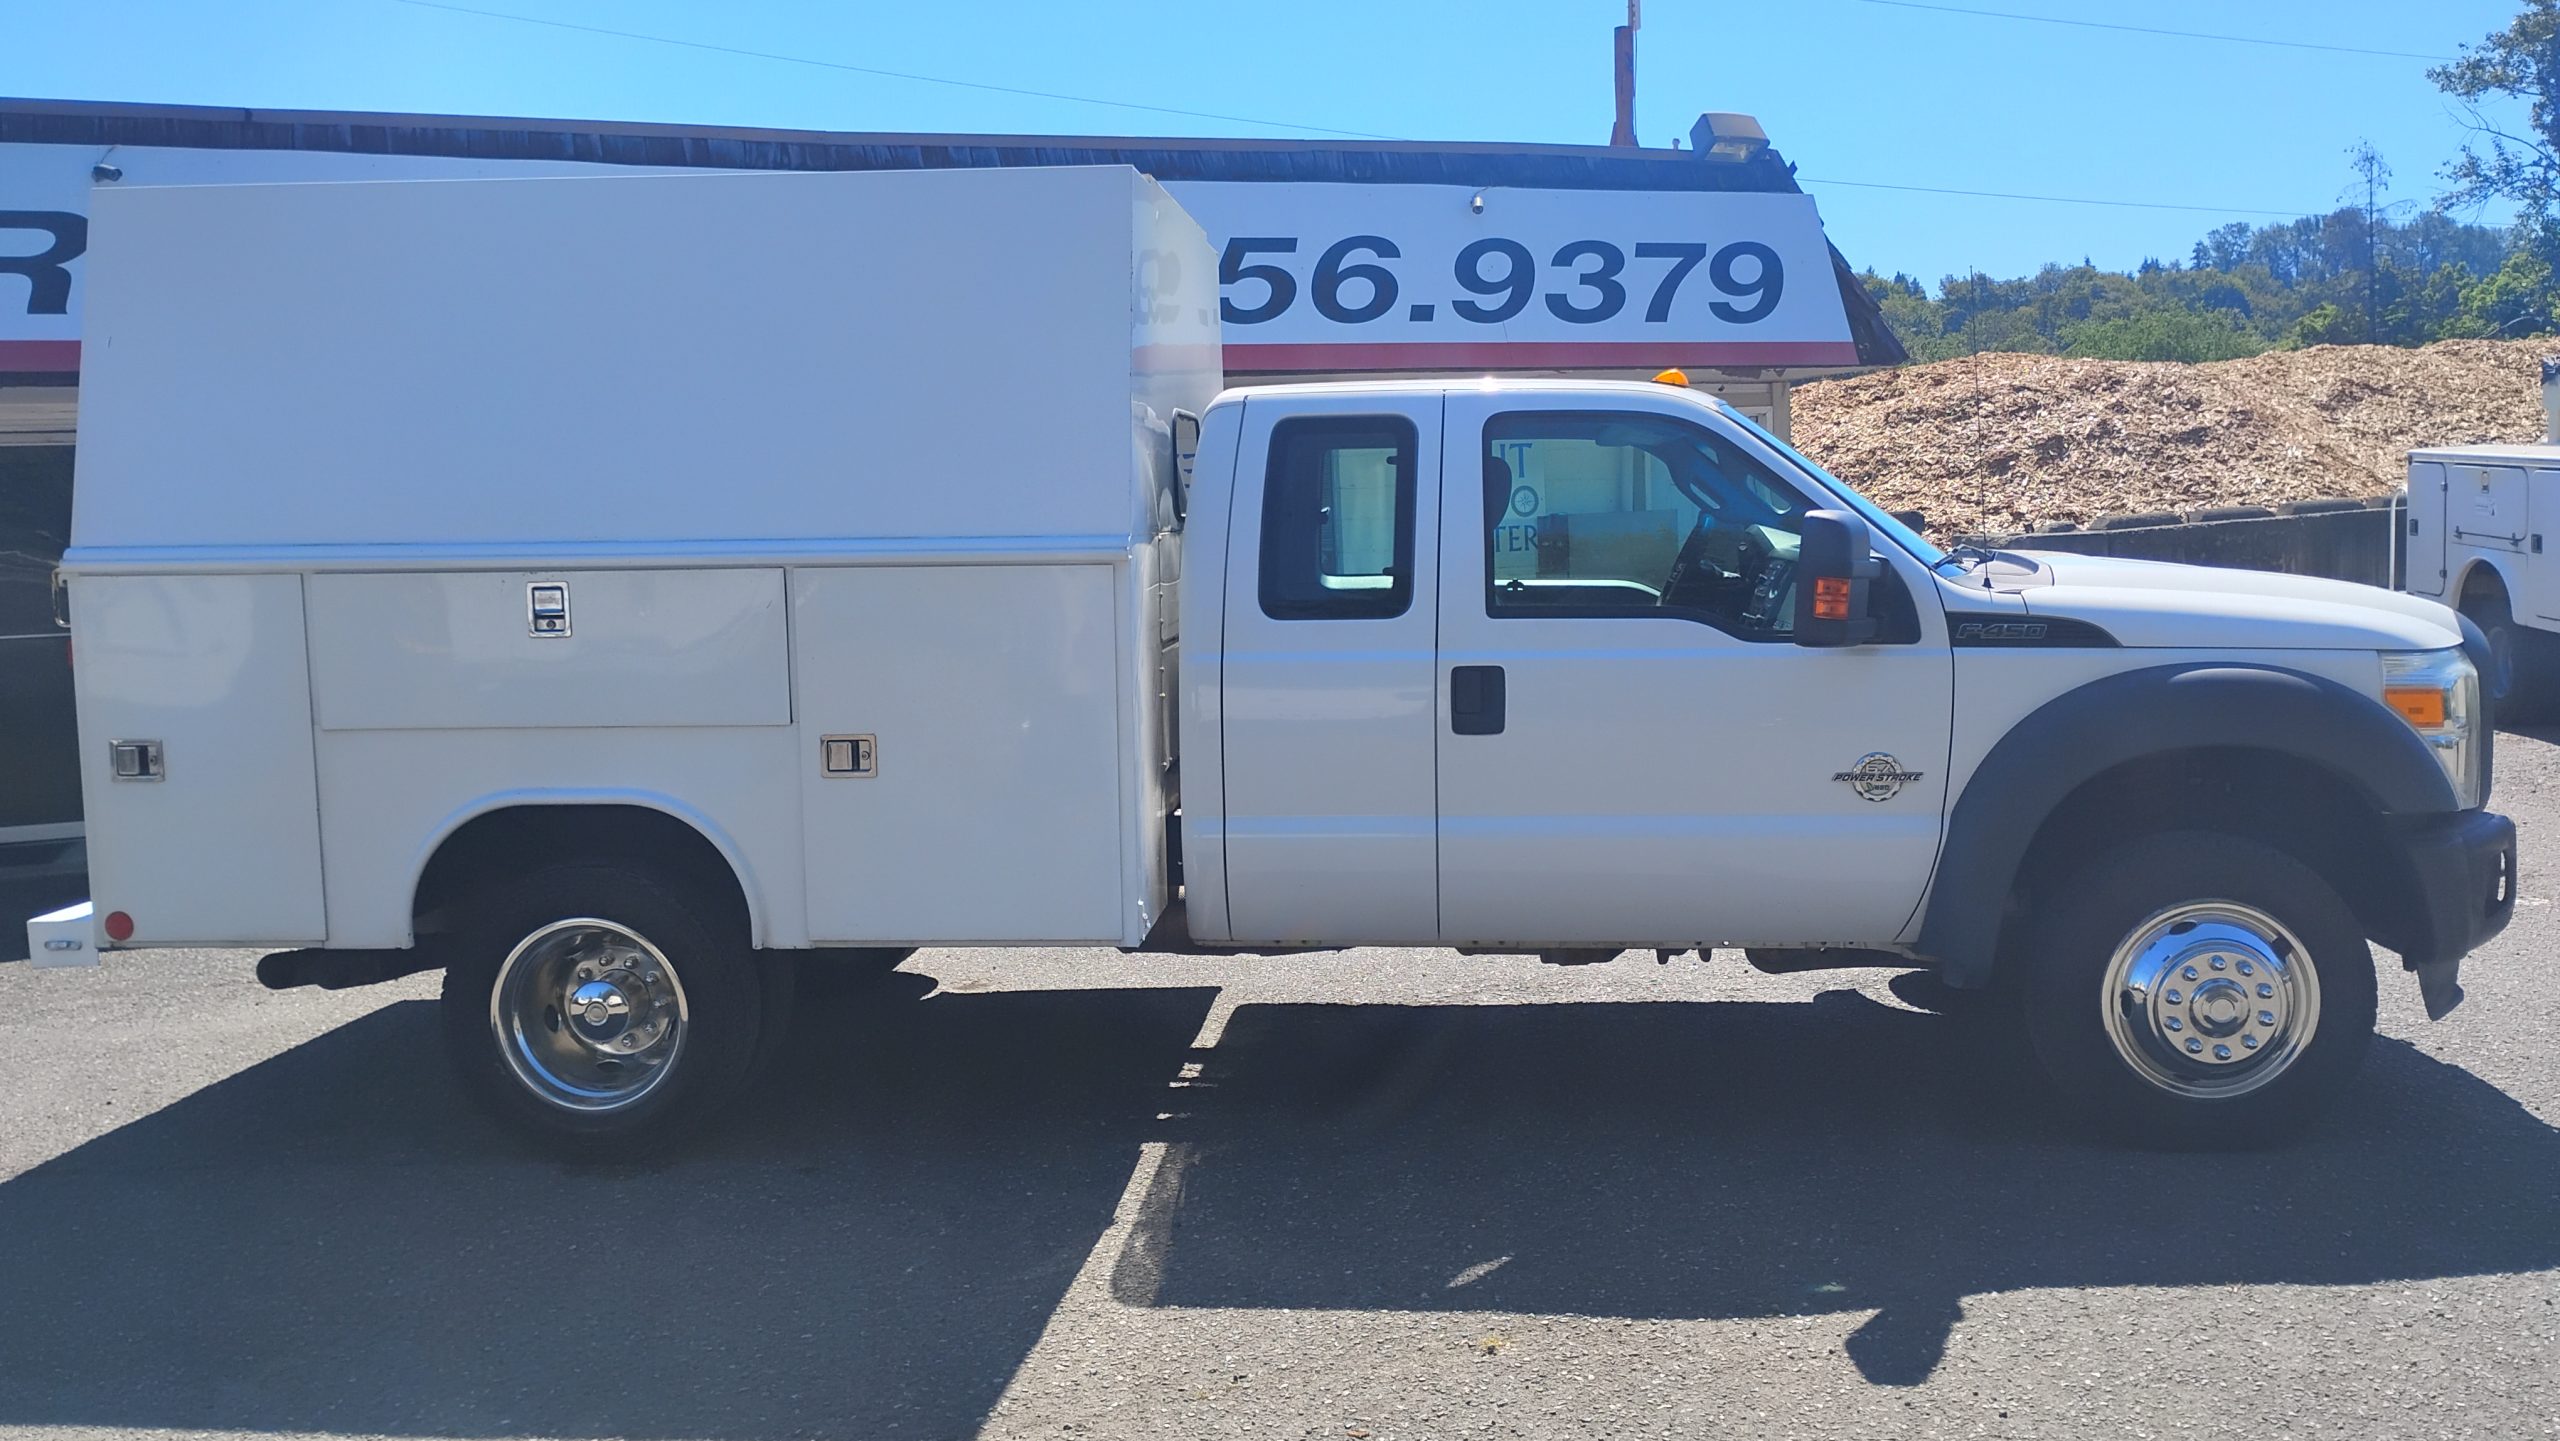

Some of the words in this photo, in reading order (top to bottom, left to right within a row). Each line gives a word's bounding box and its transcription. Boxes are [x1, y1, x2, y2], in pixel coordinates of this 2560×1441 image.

[0, 210, 89, 315] R
[1218, 235, 1784, 325] 56.9379
[1495, 524, 1538, 553] TER
[1956, 623, 2047, 639] F-450
[1833, 773, 1874, 782] POWER
[1876, 772, 1924, 782] STROKE
